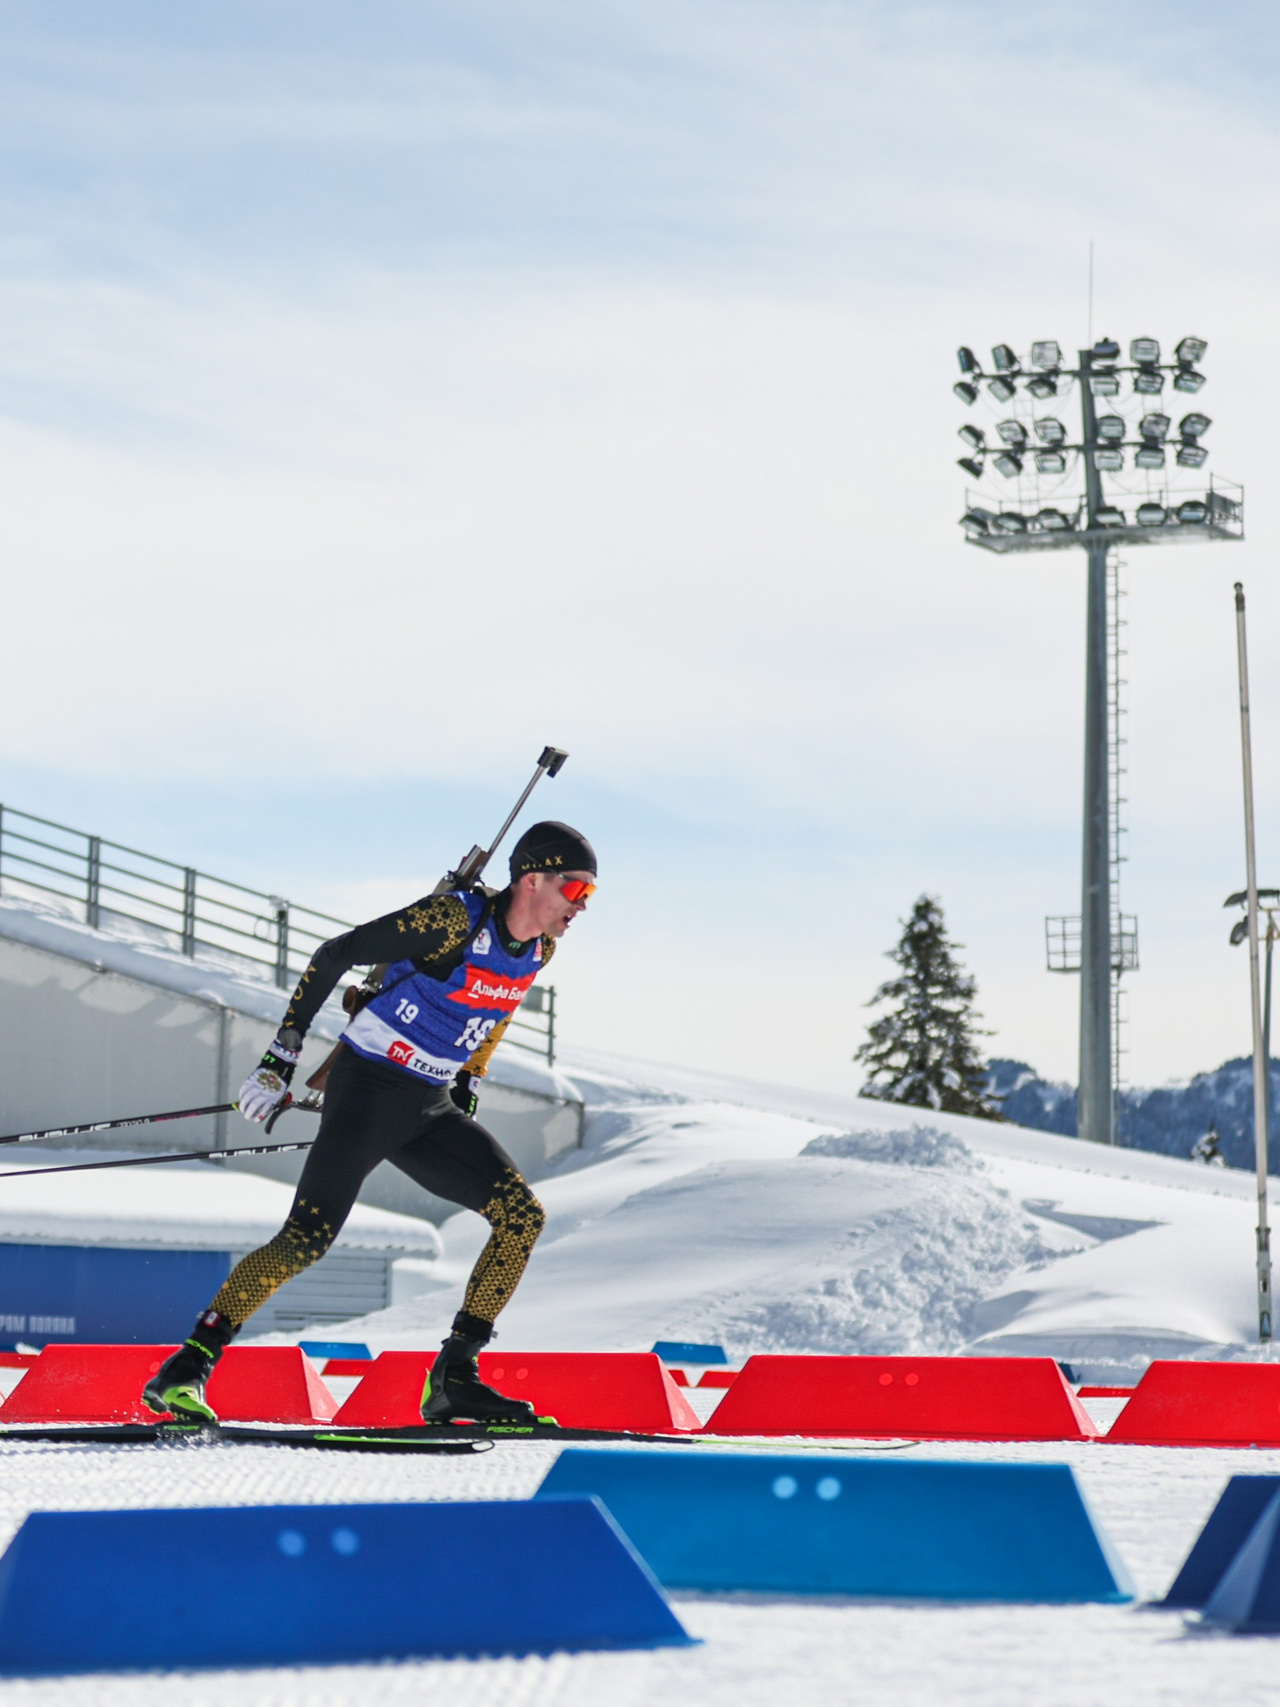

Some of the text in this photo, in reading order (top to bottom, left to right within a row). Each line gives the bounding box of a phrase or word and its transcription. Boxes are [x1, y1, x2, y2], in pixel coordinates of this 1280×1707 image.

[468, 979, 508, 1000] Альфа
[395, 998, 419, 1024] 19
[413, 1058, 452, 1078] ТЕХНО
[486, 1426, 534, 1434] FISCHER
